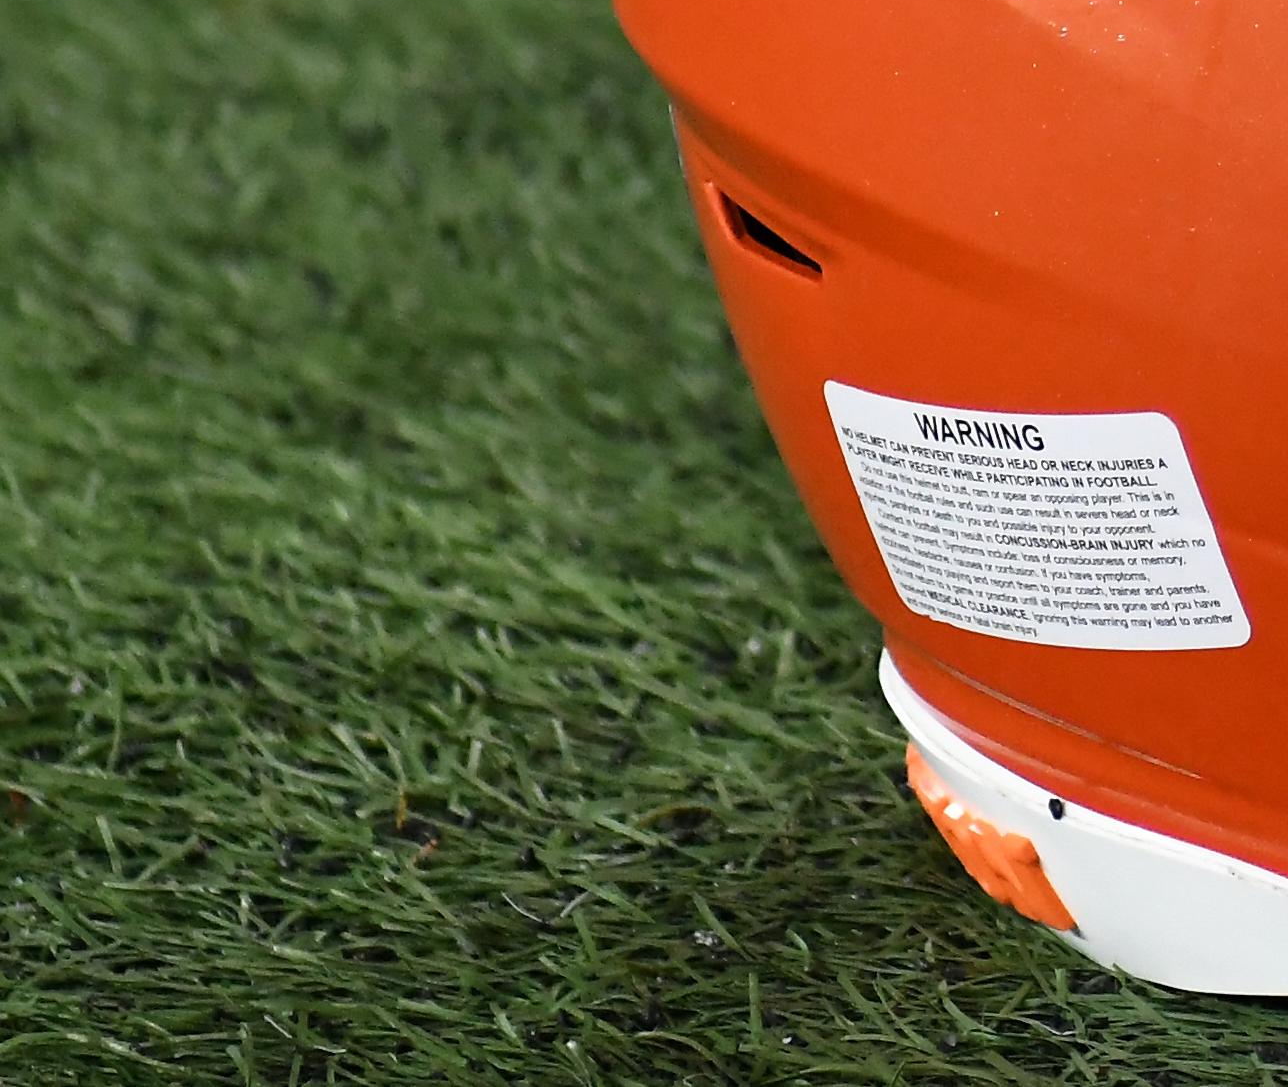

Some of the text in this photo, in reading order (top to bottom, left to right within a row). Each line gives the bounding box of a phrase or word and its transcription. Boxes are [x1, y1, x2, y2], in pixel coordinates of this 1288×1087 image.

[913, 412, 1045, 452] WARNING
[889, 440, 910, 455] CAN
[910, 445, 955, 463] PREVENT
[957, 453, 1005, 469] SERIOUS
[1005, 457, 1038, 471] HEAD
[1040, 459, 1060, 471] OR
[1060, 460, 1096, 472] NECK
[1096, 458, 1155, 471] INJURIES
[1158, 457, 1169, 469] A
[908, 460, 951, 478] RECEIVE
[950, 468, 985, 483] WHILE
[985, 472, 1070, 488] PARTICIPATING
[1071, 477, 1085, 488] IN
[1030, 494, 1043, 503] an
[1044, 494, 1090, 506] opposing
[1126, 492, 1151, 503] This
[1151, 491, 1163, 502] is
[1163, 490, 1175, 501] in
[1015, 507, 1033, 517] can
[1063, 510, 1073, 519] in
[1074, 510, 1109, 520] severe
[1109, 508, 1138, 520] head
[1139, 509, 1150, 518] or
[1153, 505, 1180, 517] neck
[1066, 524, 1078, 535] to
[1079, 526, 1101, 537] your
[994, 533, 1109, 551] CONCUSSION-BRAIN
[1109, 538, 1154, 551] INJURY
[1157, 538, 1190, 549] which
[1191, 538, 1206, 547] no
[1053, 555, 1126, 566] consciousness
[1127, 557, 1138, 566] or
[1108, 586, 1141, 597] trainer
[1144, 585, 1164, 596] and
[1103, 602, 1120, 611] are
[1121, 603, 1148, 614] gone
[1149, 600, 1170, 611] and
[1171, 601, 1193, 613] you
[1193, 599, 1221, 609] have
[1130, 619, 1152, 629] may
[1153, 615, 1178, 627] lead
[1178, 616, 1191, 626] to
[1192, 614, 1233, 626] another
